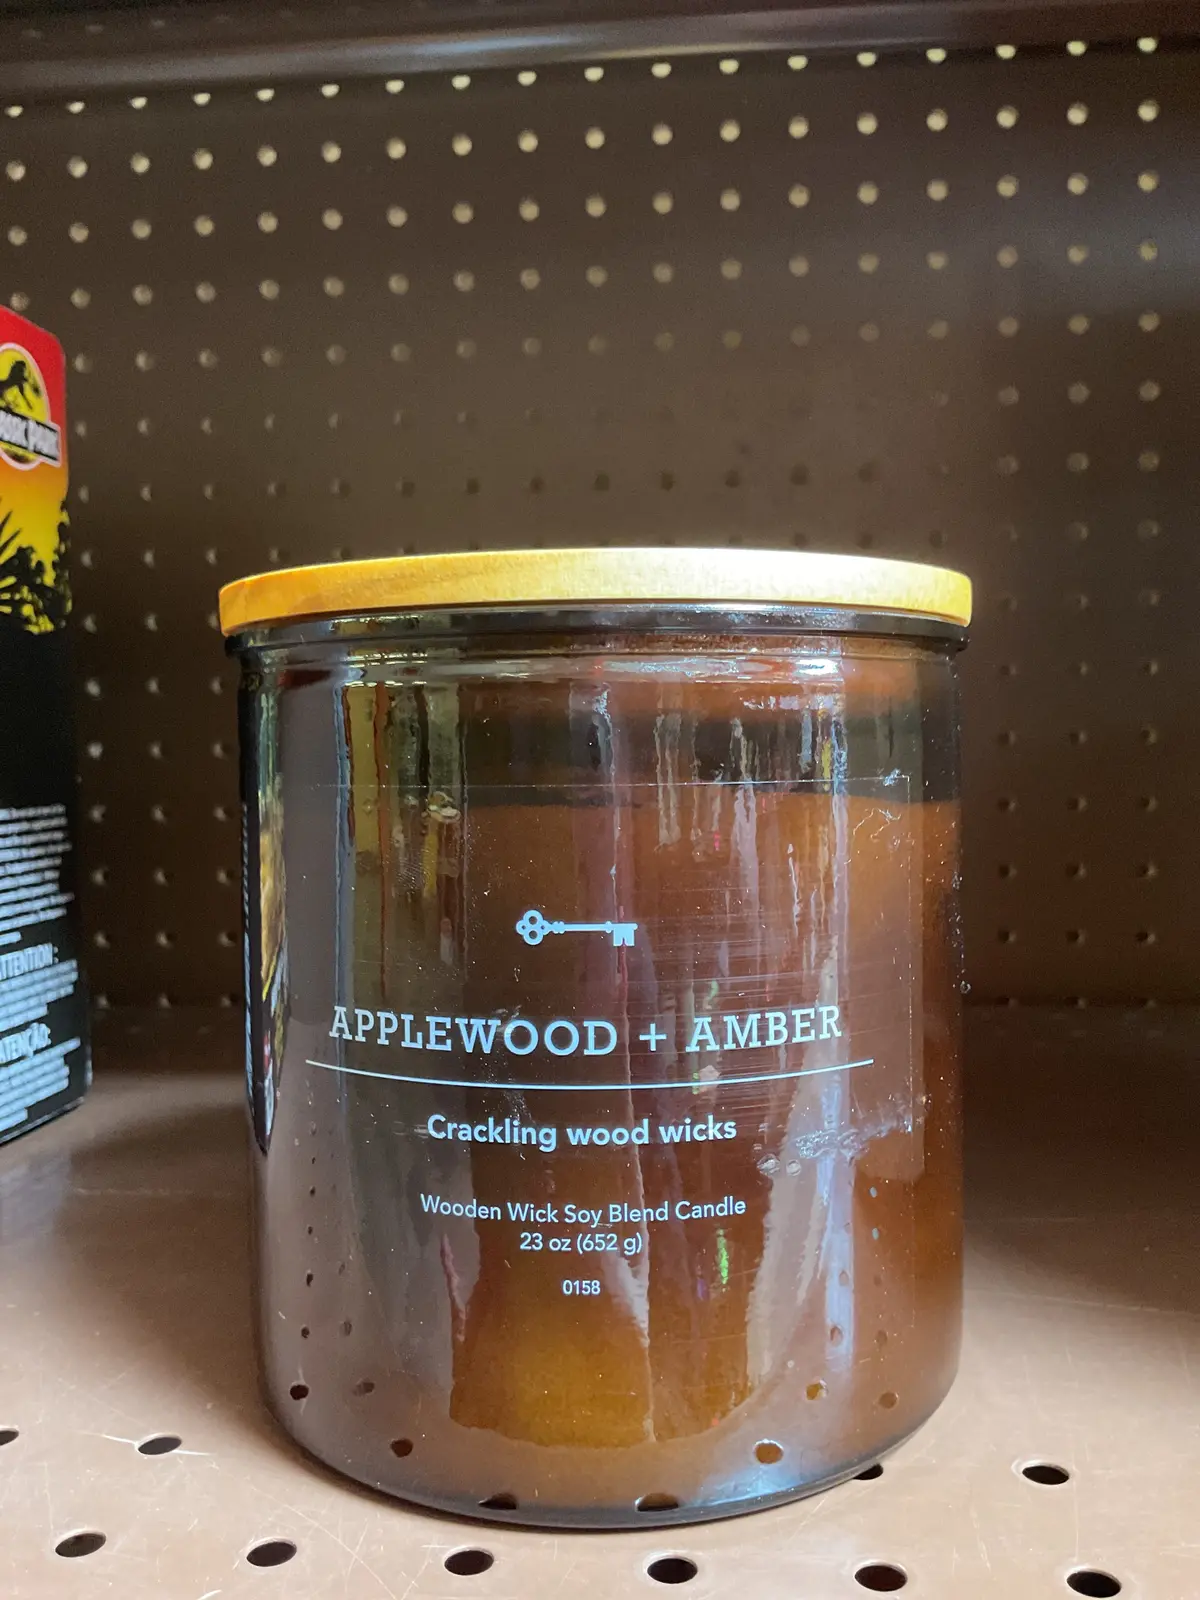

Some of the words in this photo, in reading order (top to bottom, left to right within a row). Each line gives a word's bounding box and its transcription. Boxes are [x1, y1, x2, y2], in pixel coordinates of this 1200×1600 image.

[328, 1005, 618, 1056] APPLEWOOD
[639, 1023, 667, 1052] +
[685, 1005, 842, 1053] AMBER
[427, 1113, 557, 1153] Crackling
[566, 1118, 650, 1146] wood
[658, 1114, 737, 1144] wicks
[420, 1193, 501, 1221] Wooden
[507, 1201, 558, 1223] Wick
[564, 1203, 602, 1228] Soy
[609, 1201, 668, 1223] Blend
[675, 1195, 746, 1220] Candle
[519, 1232, 543, 1250] 23
[549, 1236, 572, 1251] oz
[576, 1232, 618, 1254] (652
[623, 1232, 643, 1255] g)
[562, 1280, 601, 1296] 0158
